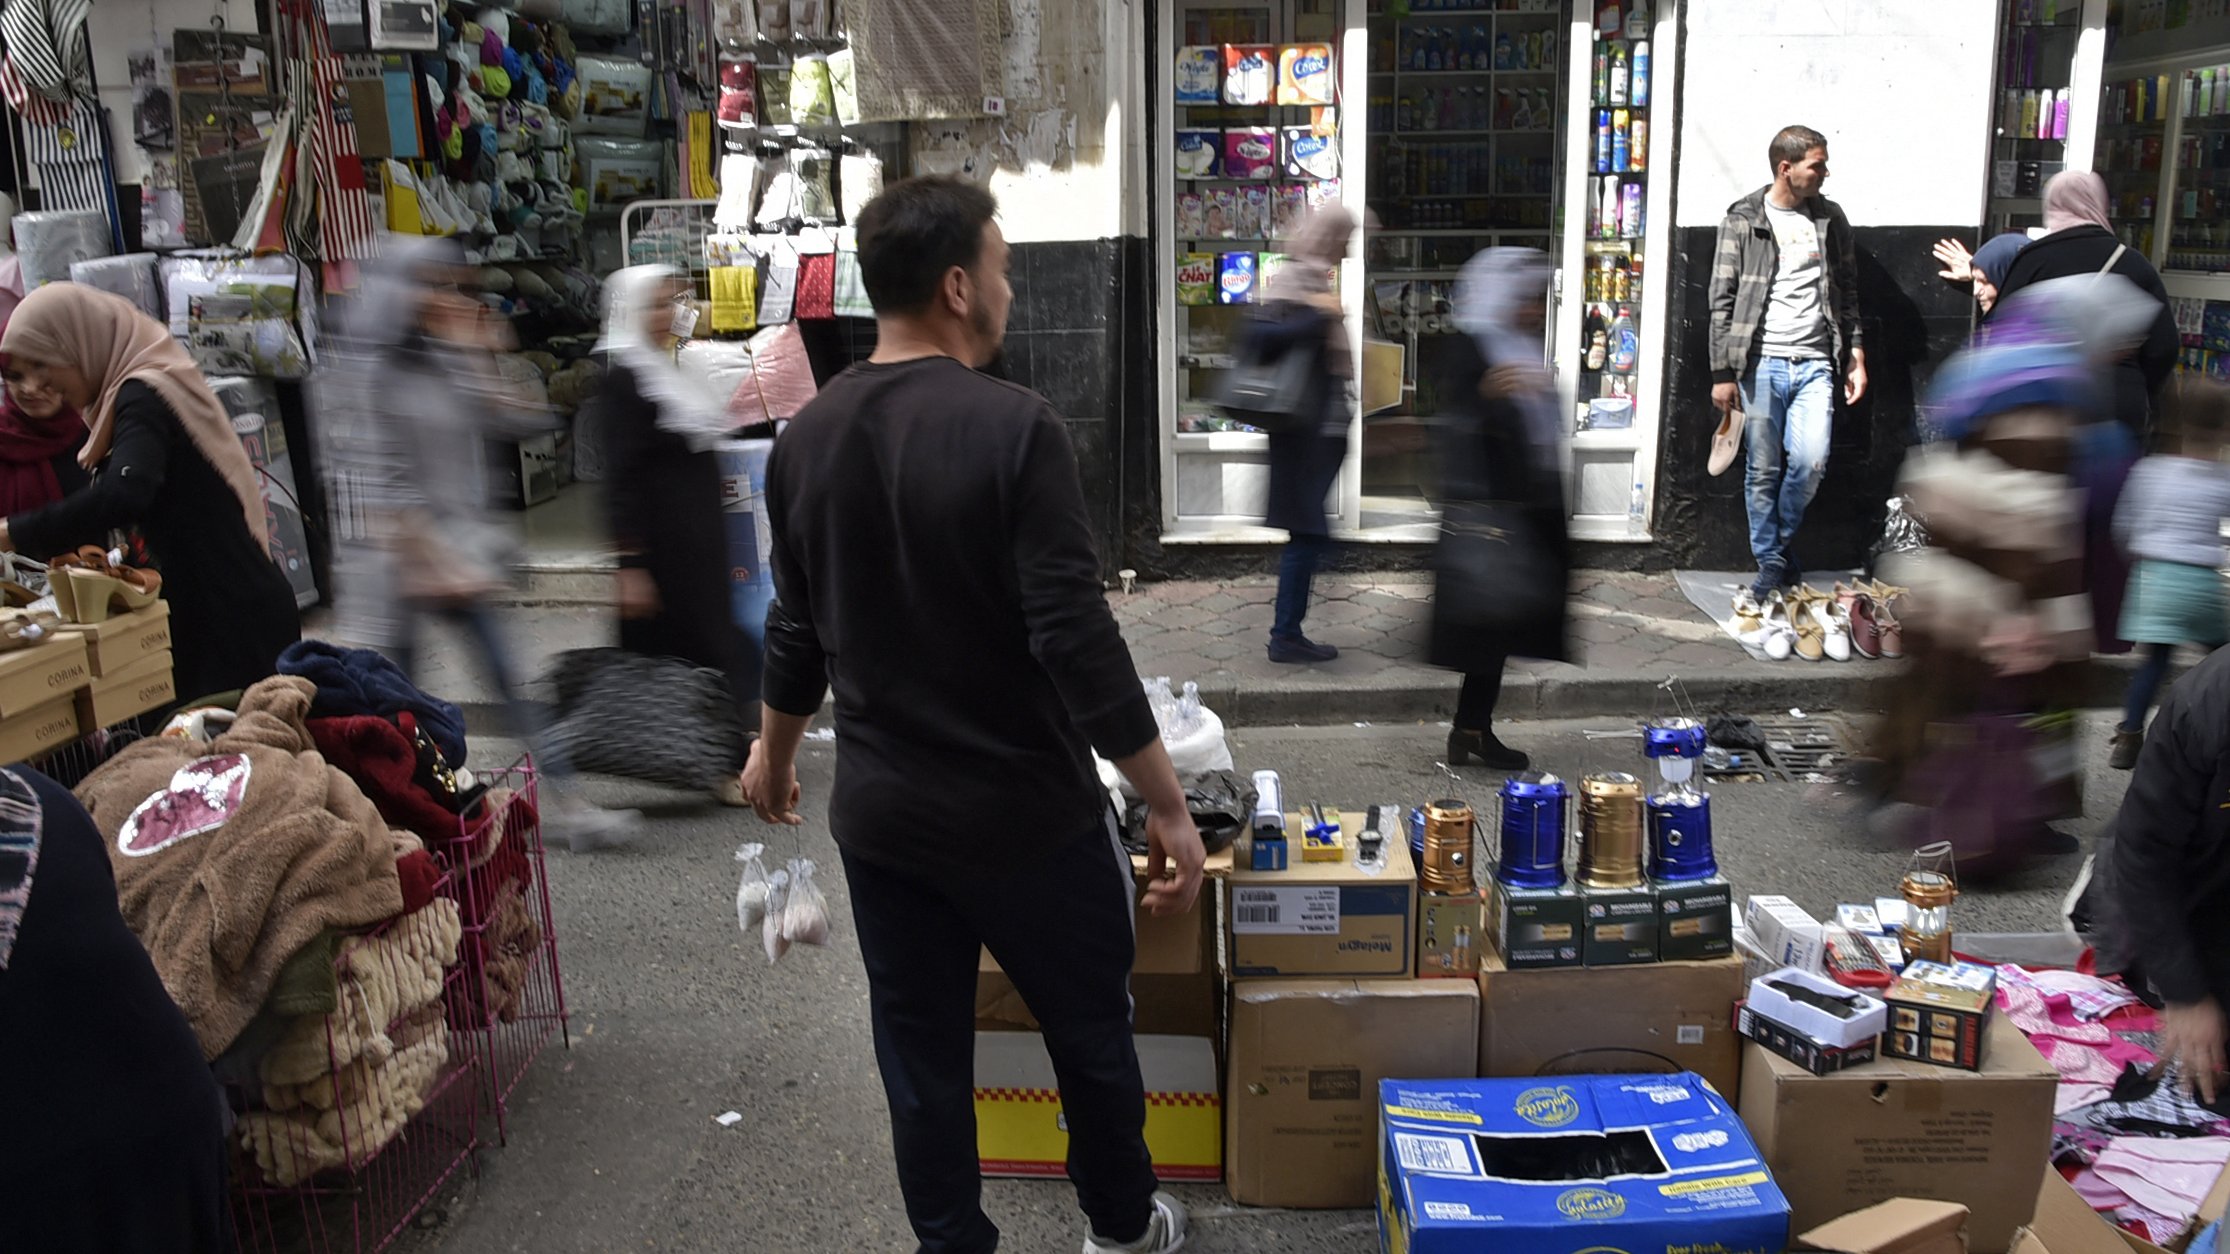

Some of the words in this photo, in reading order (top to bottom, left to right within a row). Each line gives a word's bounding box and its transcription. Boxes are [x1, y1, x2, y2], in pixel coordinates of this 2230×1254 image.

[140, 630, 168, 649] CORINA
[47, 664, 85, 688] CORINA
[138, 680, 170, 703] CORINA
[35, 717, 72, 741] CORINA
